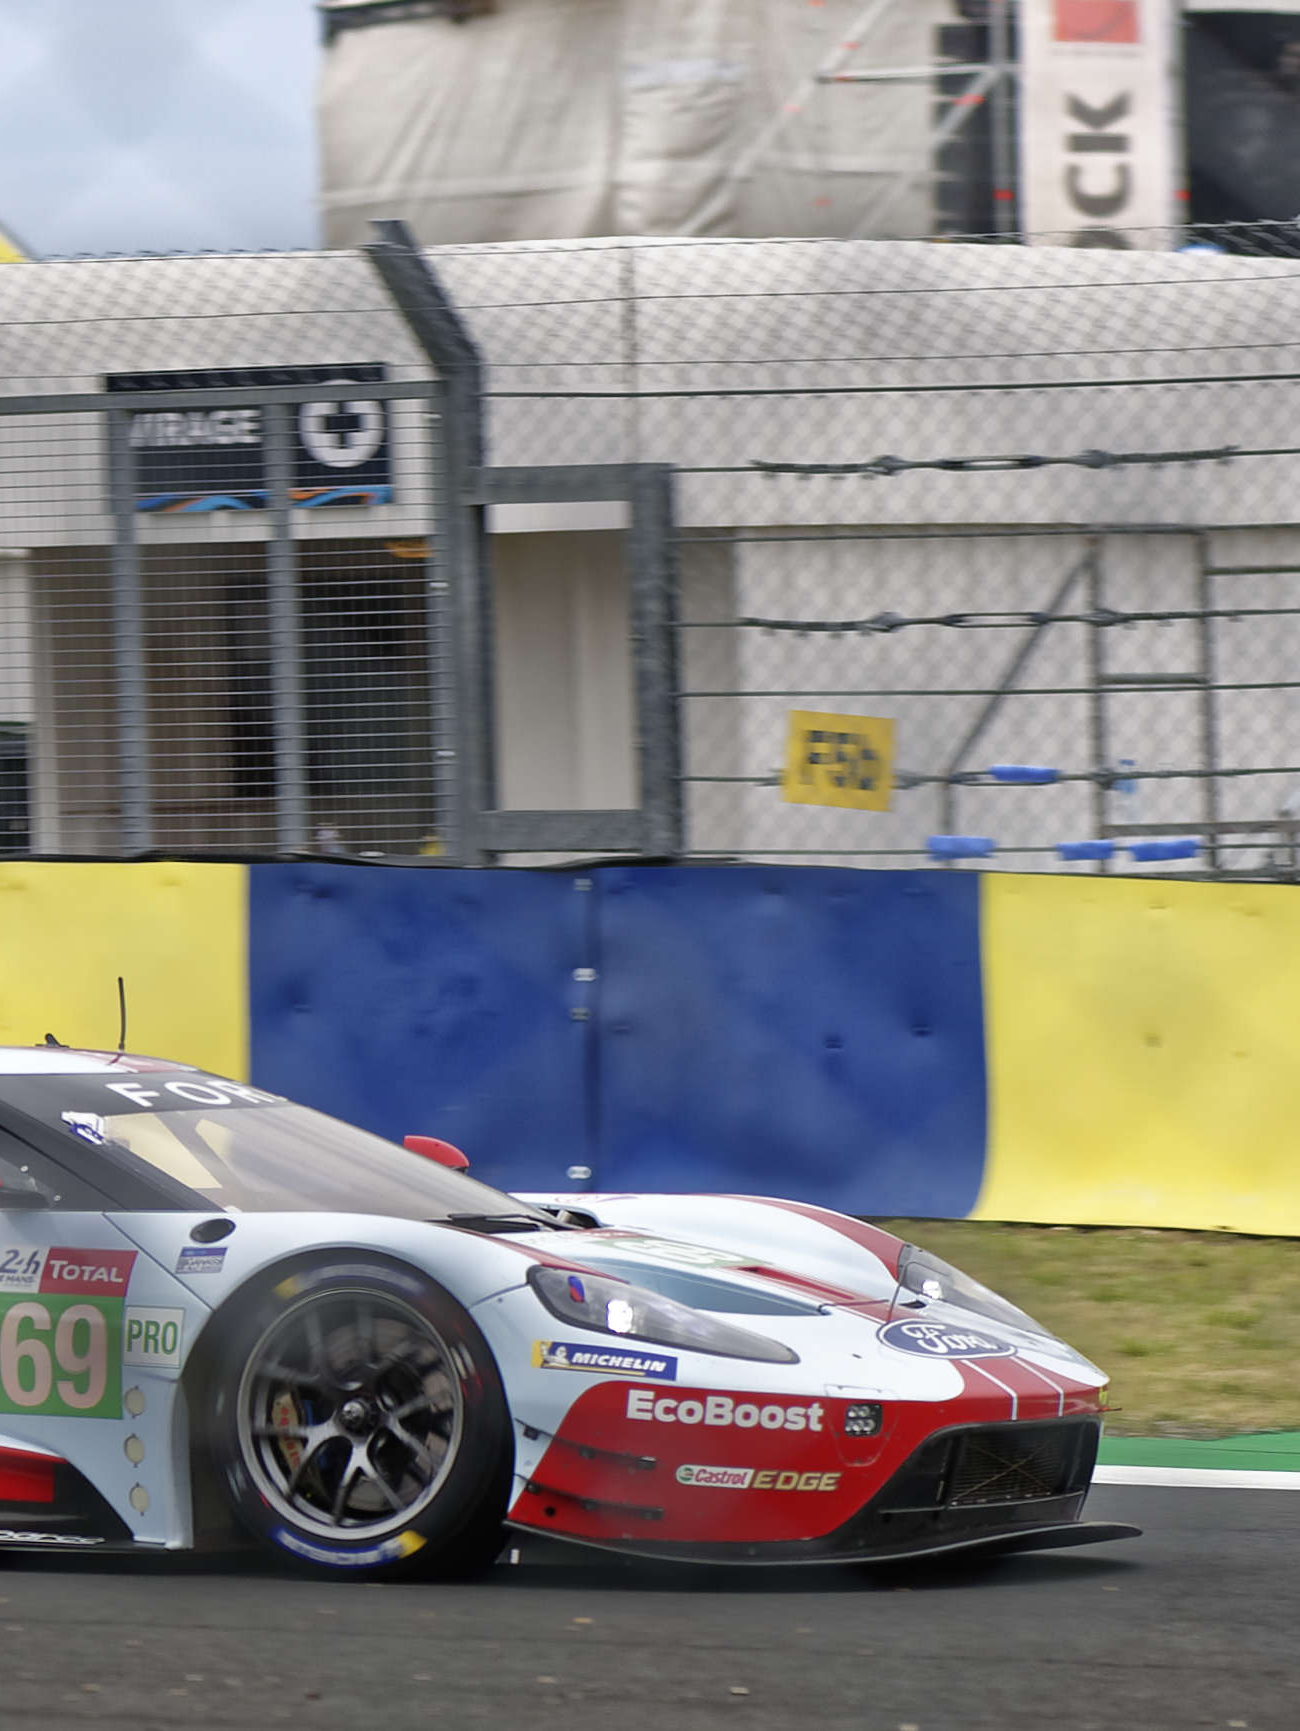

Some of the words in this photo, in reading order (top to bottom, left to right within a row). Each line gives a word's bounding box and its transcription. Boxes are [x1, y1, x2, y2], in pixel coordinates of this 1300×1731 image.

[105, 1080, 288, 1107] FOR
[49, 1260, 124, 1284] TOTAL
[126, 1319, 178, 1356] PRO
[0, 1302, 107, 1409] 69
[572, 1352, 667, 1373] MICHELIN
[626, 1389, 825, 1432] EcoBoost
[694, 1468, 747, 1486] Castrol
[752, 1470, 843, 1491] EDGE
